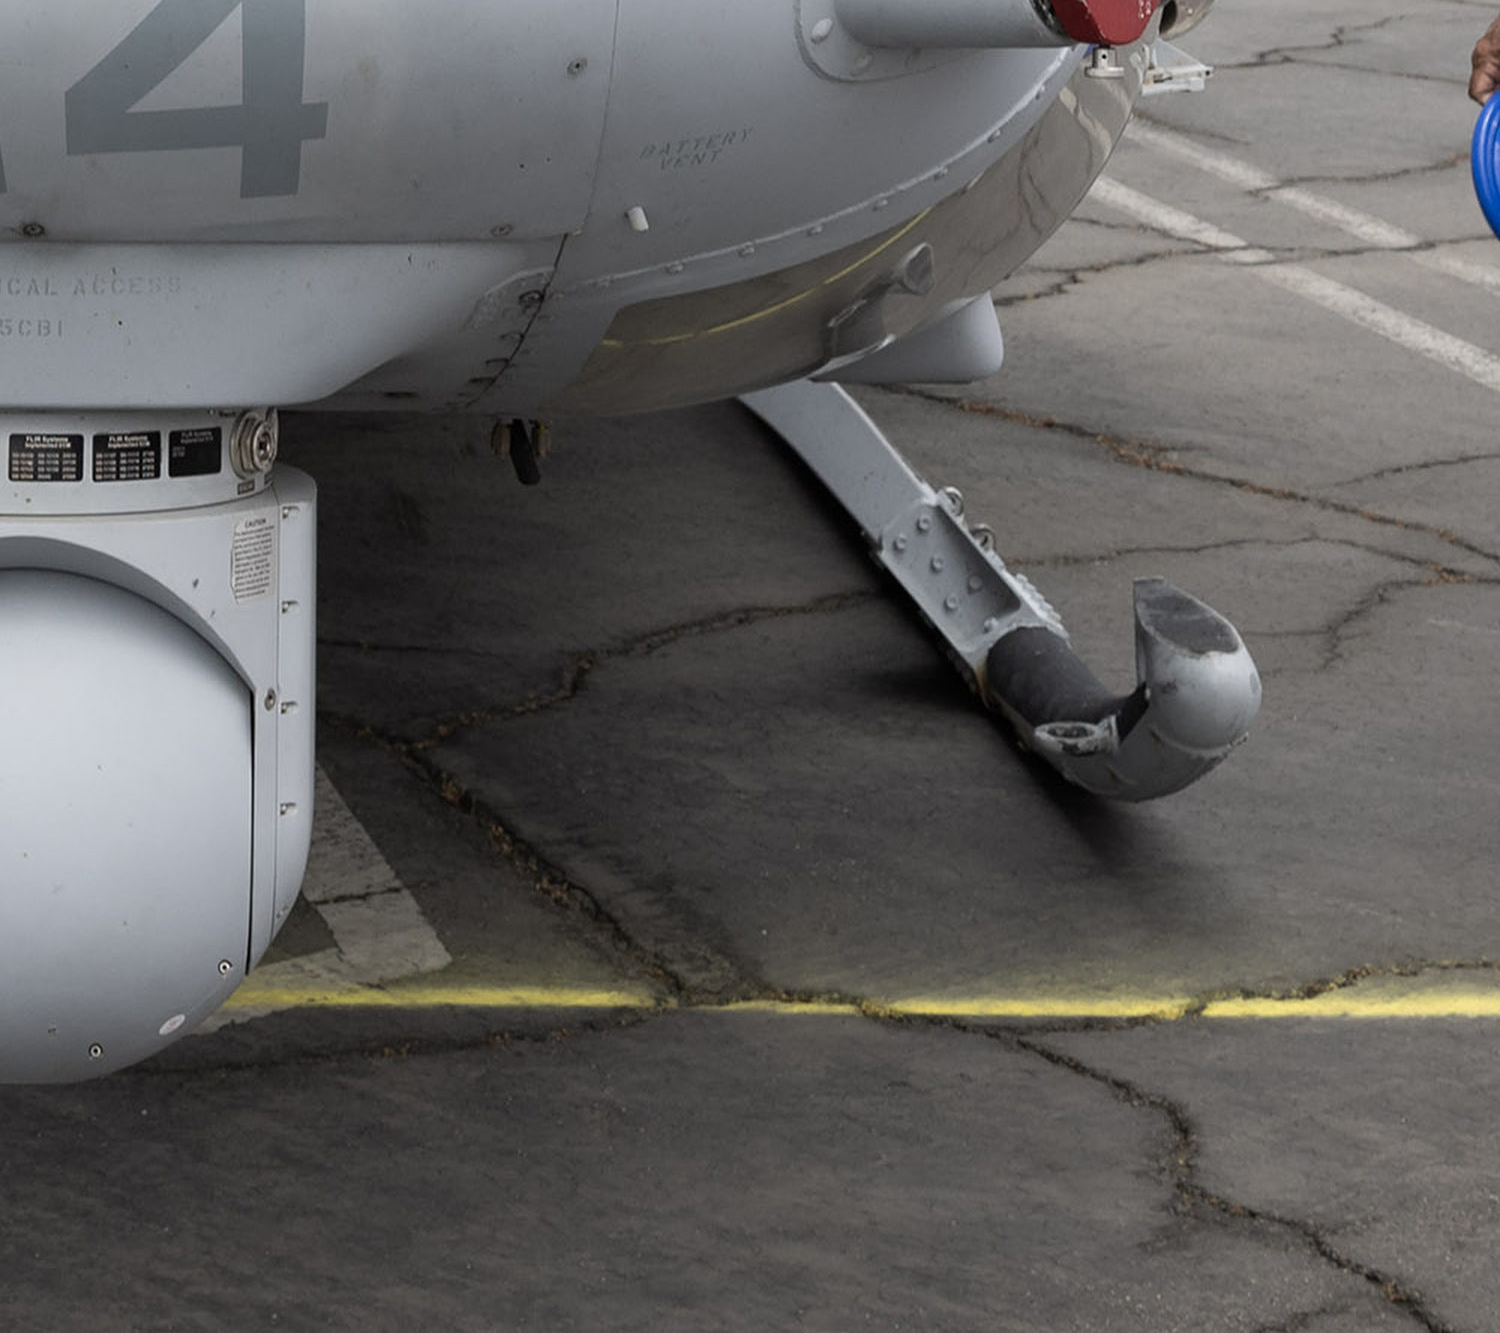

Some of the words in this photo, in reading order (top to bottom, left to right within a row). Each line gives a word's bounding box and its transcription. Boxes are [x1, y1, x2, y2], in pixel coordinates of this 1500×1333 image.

[640, 126, 753, 159] BATTERY
[661, 148, 722, 170] VENT
[72, 275, 182, 297] ACCESS
